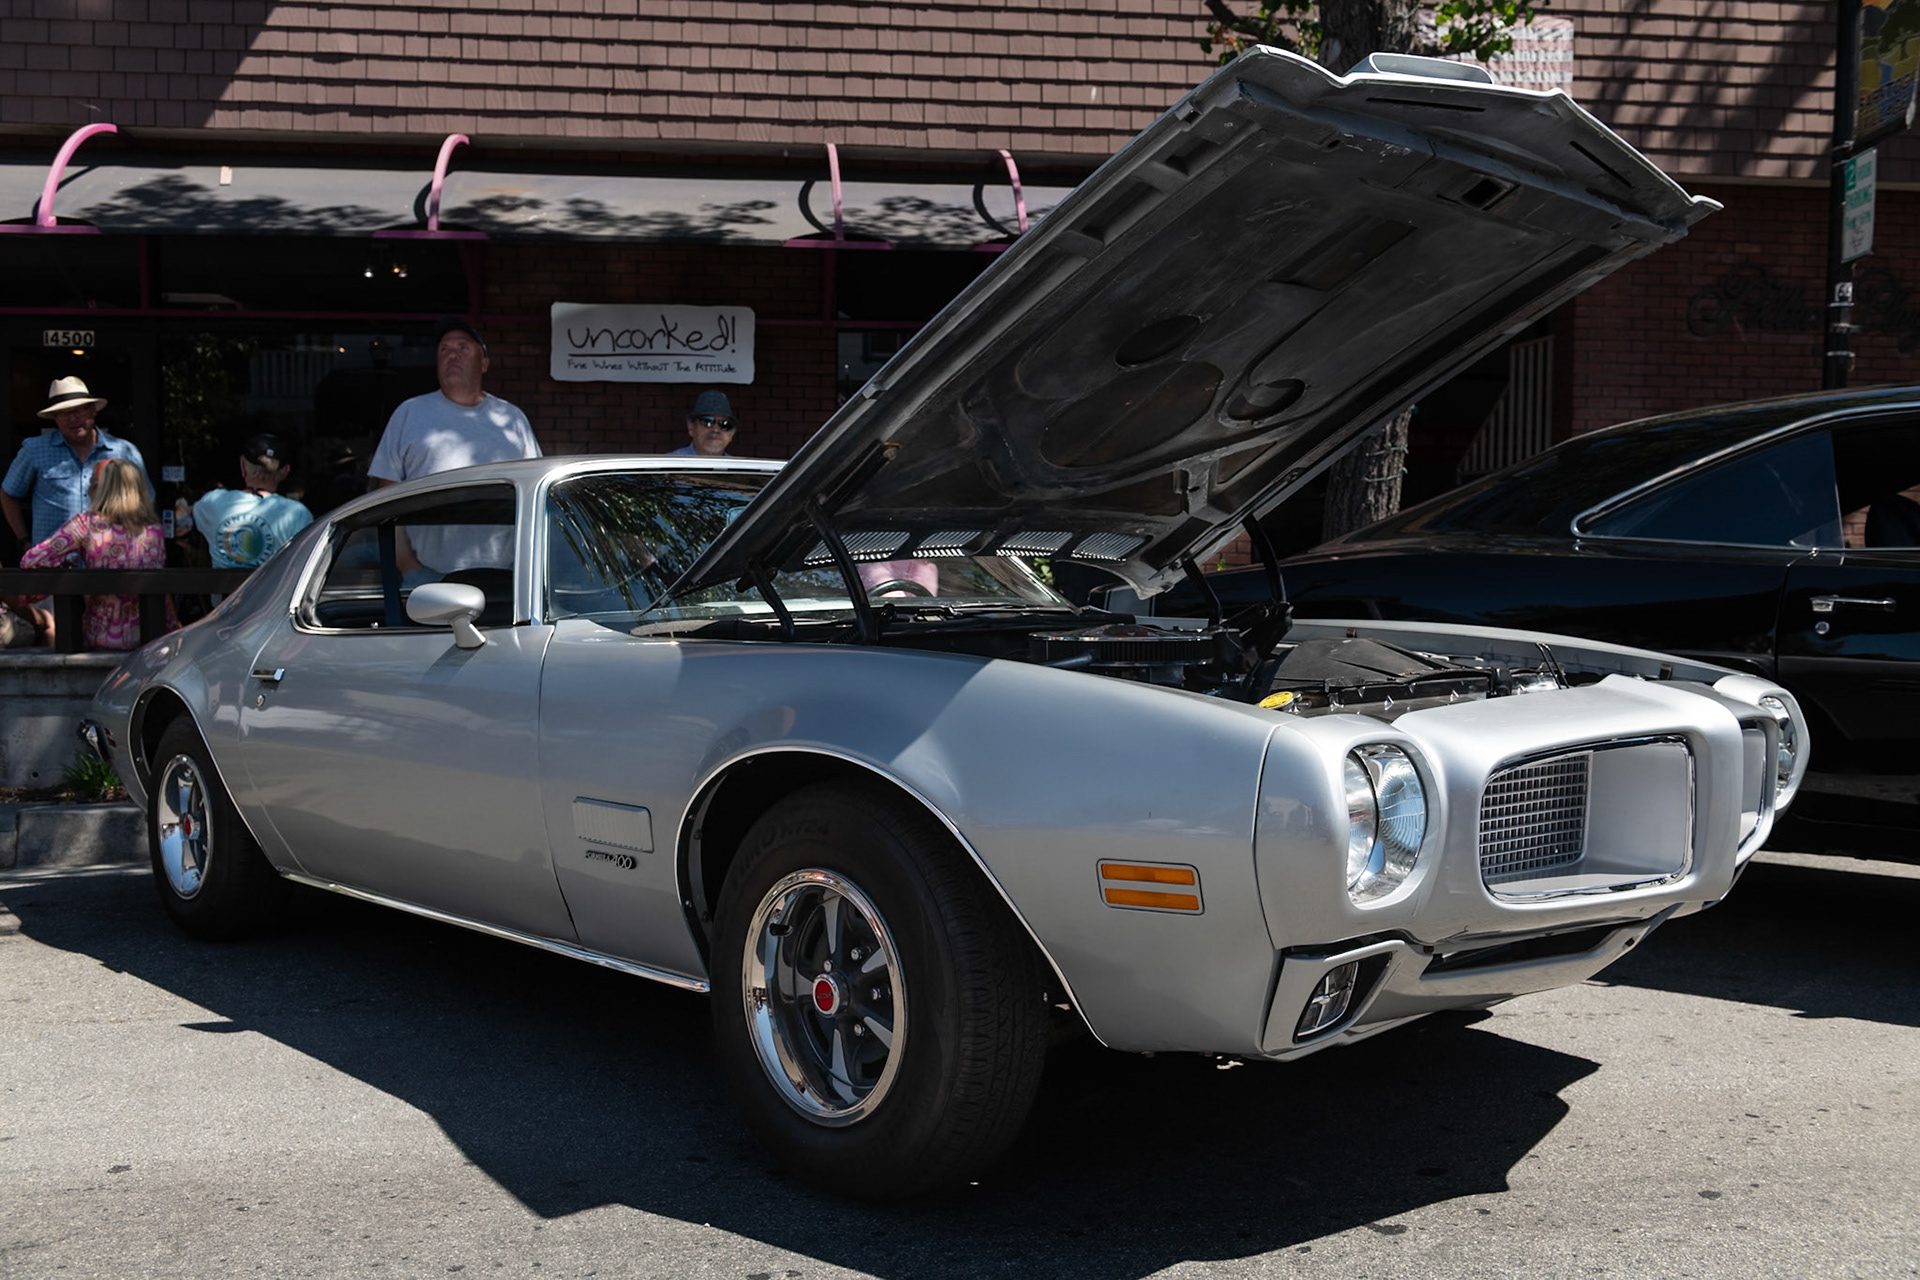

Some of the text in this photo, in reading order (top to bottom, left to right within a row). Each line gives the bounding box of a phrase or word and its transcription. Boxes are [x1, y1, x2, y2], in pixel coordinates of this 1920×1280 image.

[44, 331, 93, 346] 14500
[567, 314, 736, 353] uncorked!
[567, 359, 588, 370] Fine
[592, 360, 623, 371] Wines
[673, 361, 691, 372] The
[610, 855, 632, 869] 400
